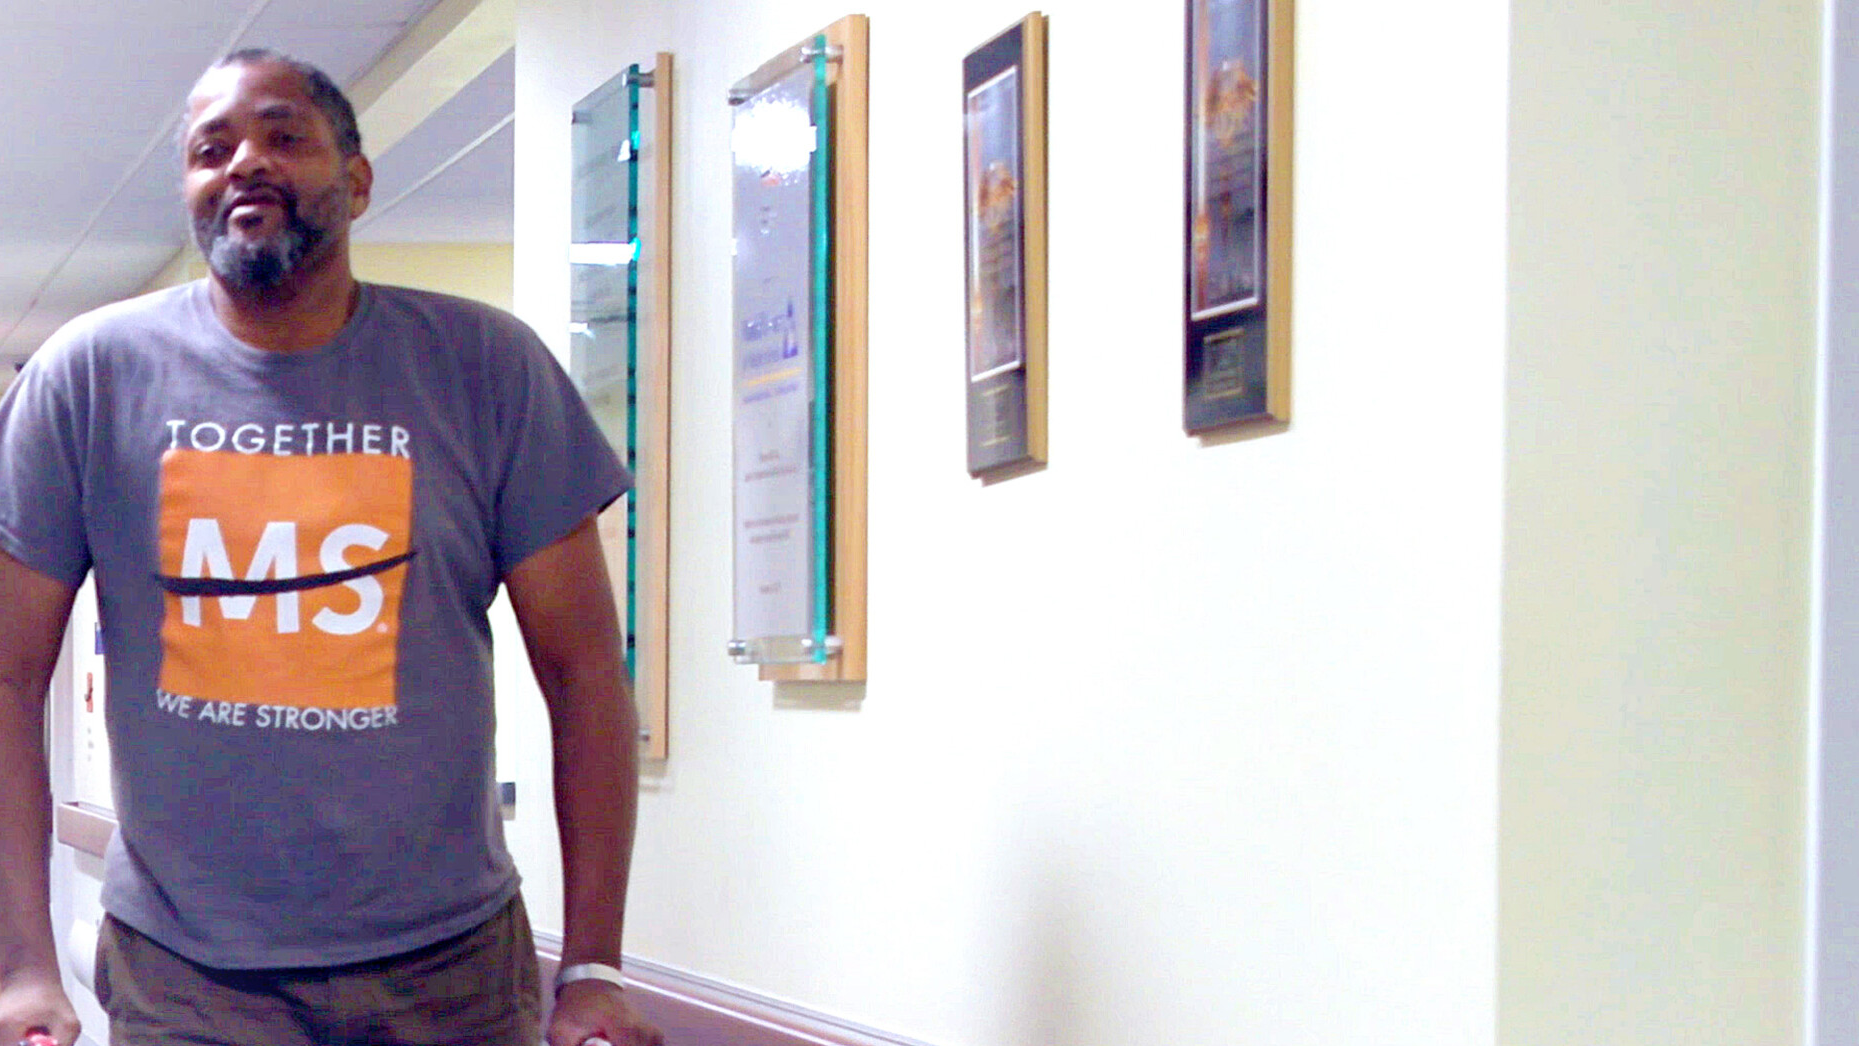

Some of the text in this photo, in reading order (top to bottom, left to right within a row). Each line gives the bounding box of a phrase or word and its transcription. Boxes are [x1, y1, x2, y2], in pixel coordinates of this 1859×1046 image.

[166, 419, 411, 459] TOGETHER
[156, 688, 398, 731] WE ARE STRONGER
